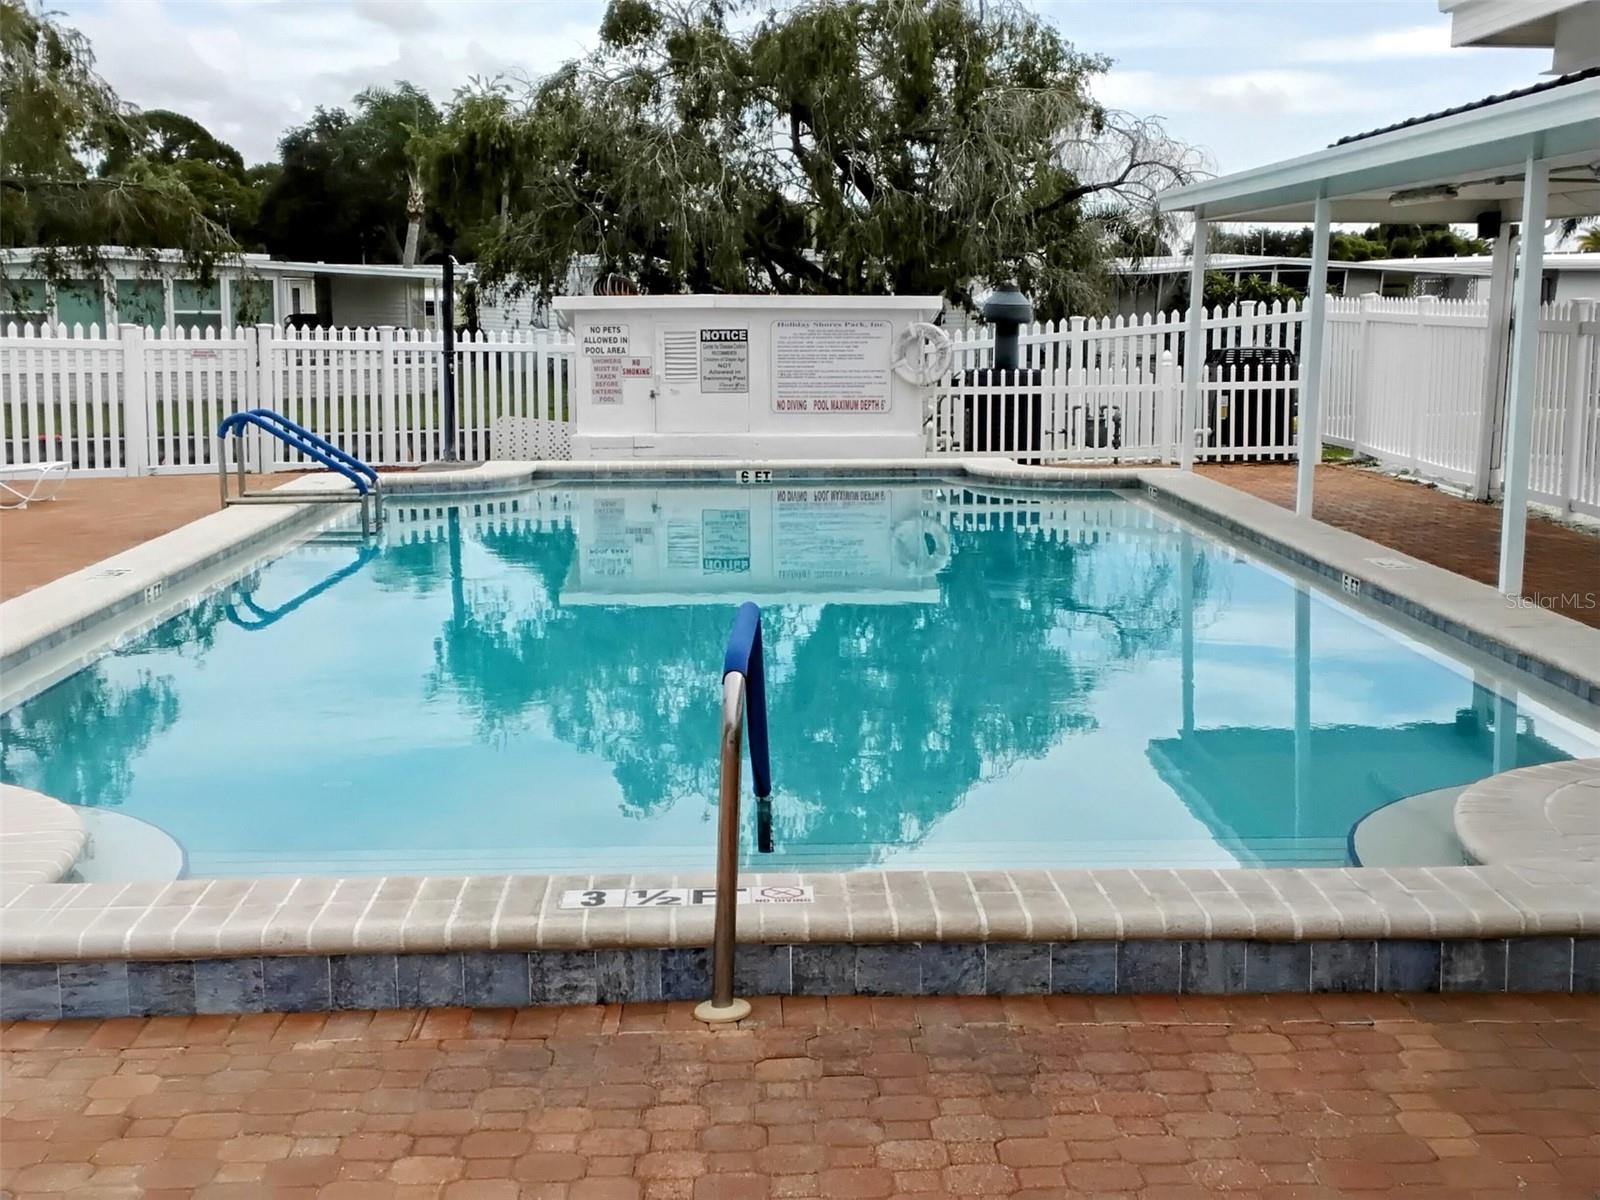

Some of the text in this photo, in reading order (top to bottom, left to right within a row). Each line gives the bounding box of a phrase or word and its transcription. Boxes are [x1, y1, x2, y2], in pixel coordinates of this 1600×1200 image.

[590, 326, 621, 334] NO PETS
[584, 336, 628, 344] ALLOWED IN
[702, 330, 747, 341] NOTICE
[622, 367, 650, 375] SMOKING
[776, 400, 785, 410] NO
[787, 400, 807, 410] DIVING
[813, 400, 829, 410] POOL
[830, 400, 859, 410] MAXIMUM
[860, 400, 879, 410] DEPTH
[741, 471, 749, 483] 6
[580, 890, 606, 907] 3
